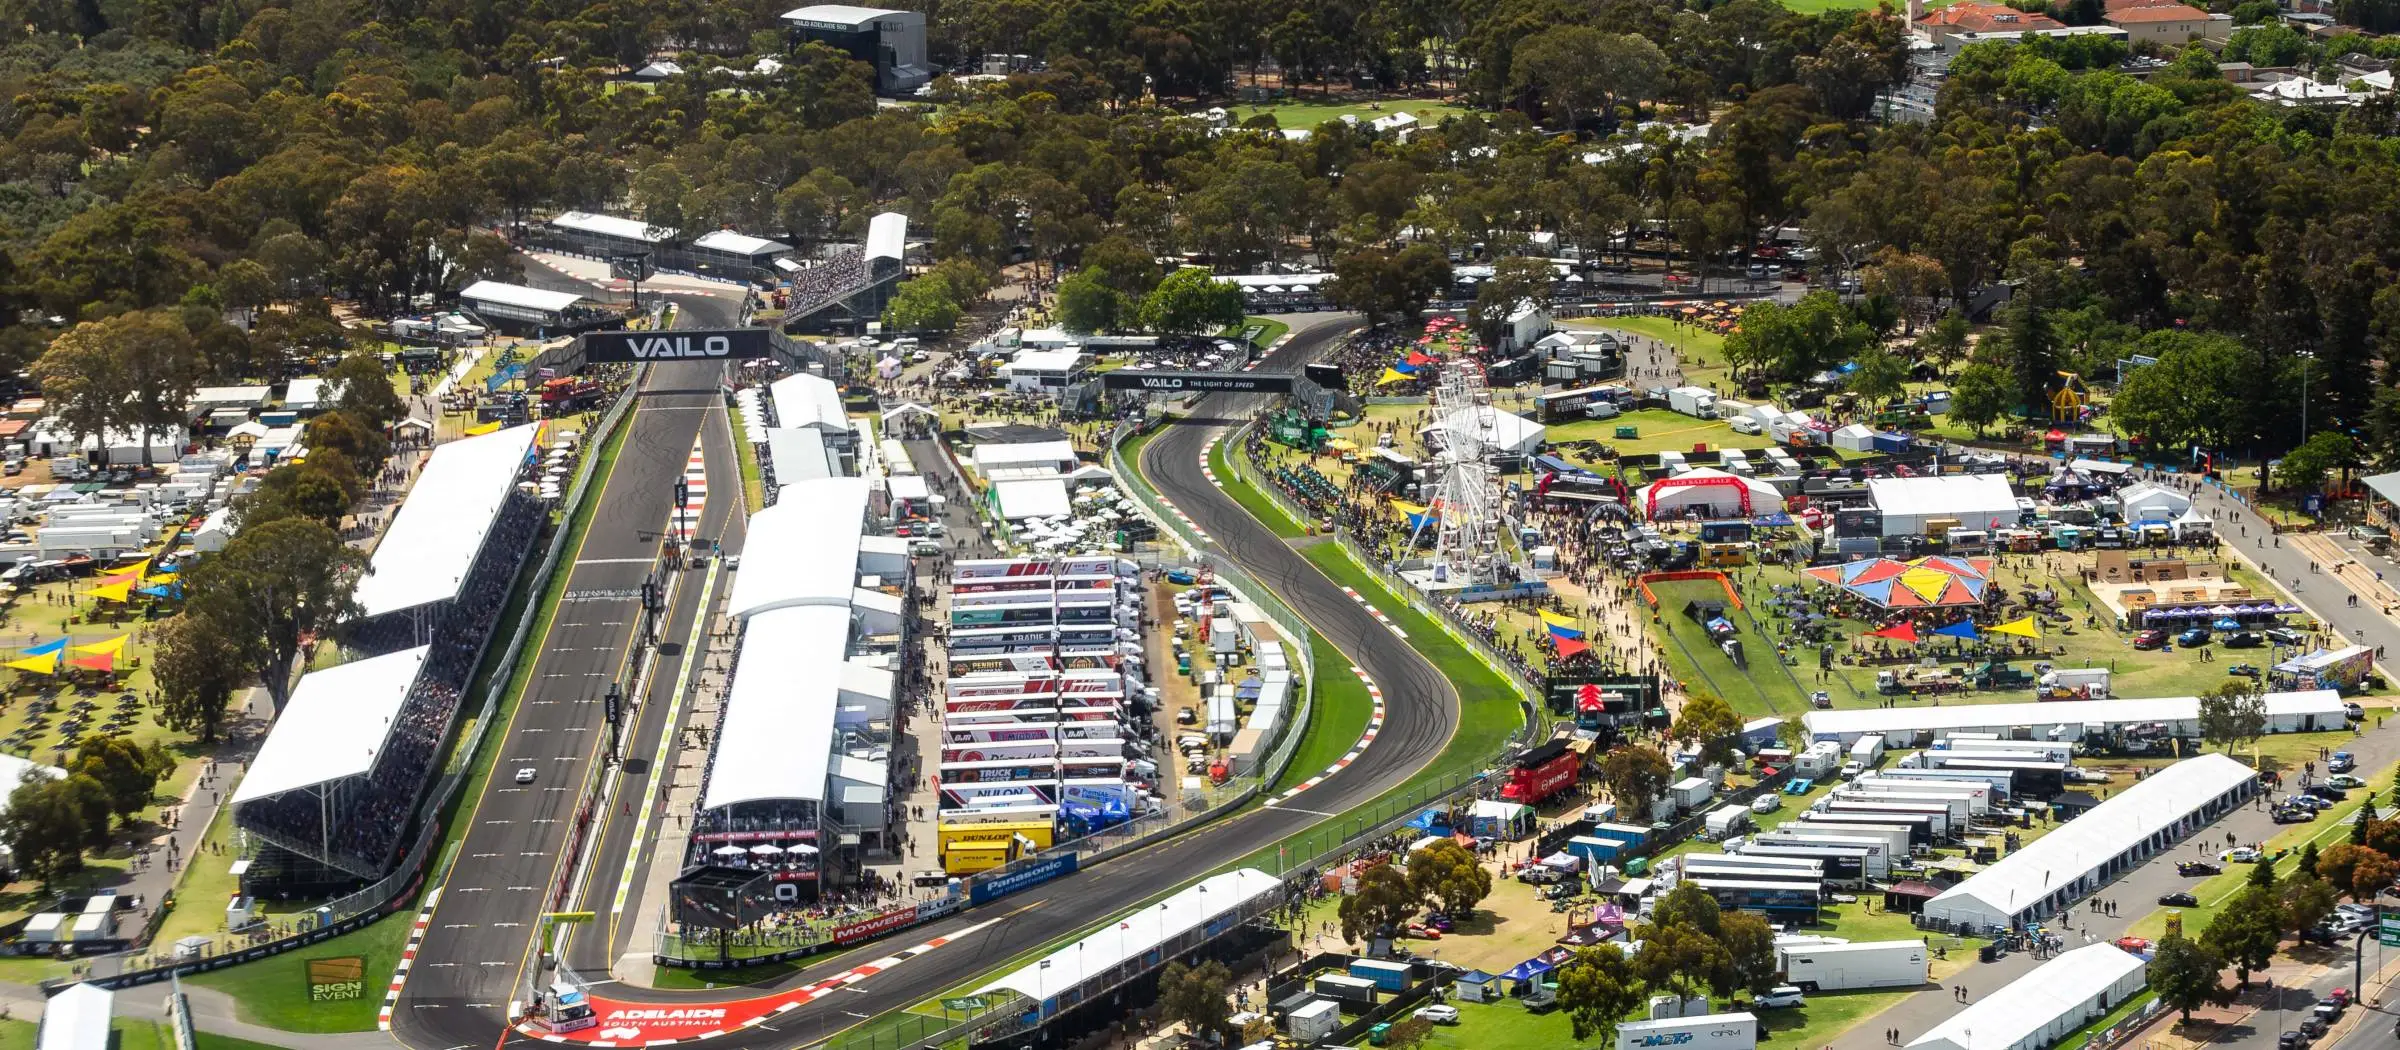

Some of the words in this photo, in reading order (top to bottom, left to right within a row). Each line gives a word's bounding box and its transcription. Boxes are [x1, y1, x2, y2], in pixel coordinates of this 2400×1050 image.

[626, 336, 730, 358] VAILO
[1141, 378, 1183, 388] VAILO
[972, 661, 1003, 669] PENRITE
[608, 697, 616, 721] VAILO
[980, 768, 1012, 777] TRUCK
[1548, 770, 1569, 786] HINO
[987, 860, 1062, 892] Panasonic
[837, 910, 914, 939] MOWERS
[313, 981, 361, 993] SIGN
[313, 990, 361, 1001] EVENT
[607, 1009, 726, 1019] ADELAIDE
